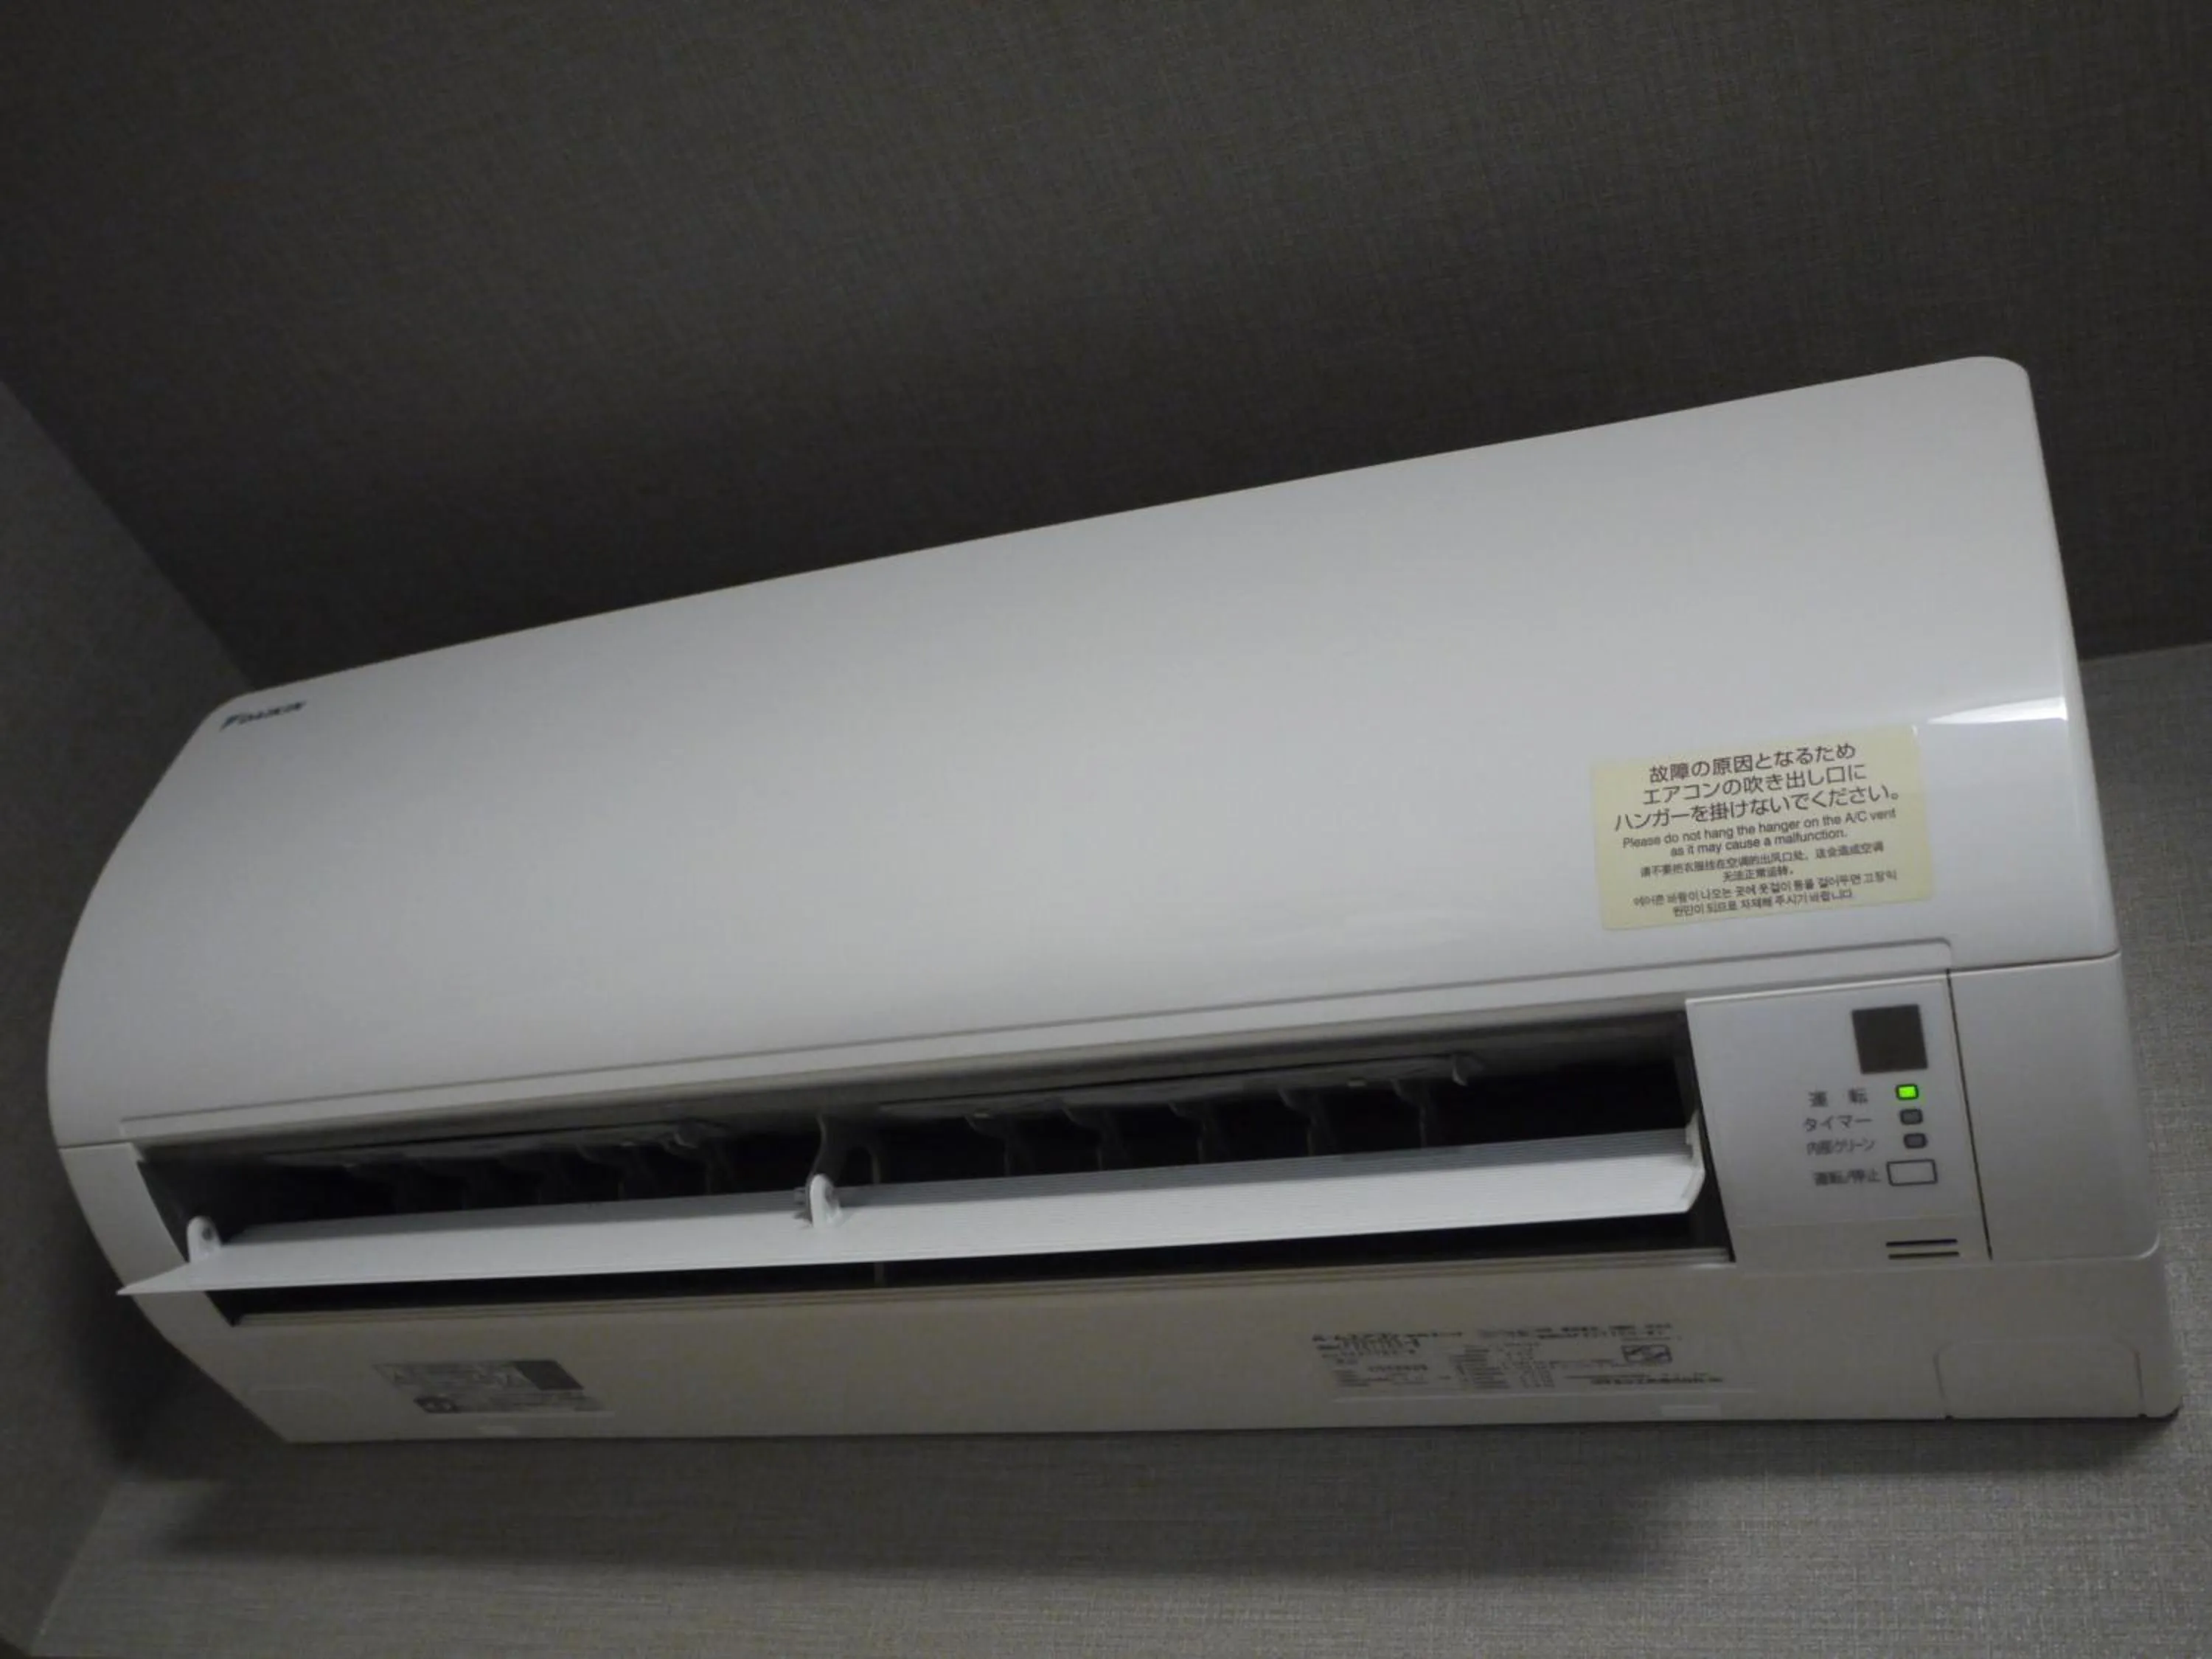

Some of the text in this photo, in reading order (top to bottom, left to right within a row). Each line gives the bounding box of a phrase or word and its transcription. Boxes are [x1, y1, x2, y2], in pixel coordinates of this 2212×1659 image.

[1649, 742, 1856, 784] 故障の原因となるため
[1642, 764, 1868, 805] エアコンの吹き出し口に
[1613, 784, 1899, 832] ハンガーを掛けないでください。
[1622, 808, 1896, 849] Please do not hang the hanger on the A/C vent
[1670, 829, 1848, 858] as it may cause a malfunction.
[1804, 1114, 1874, 1133] タイマー
